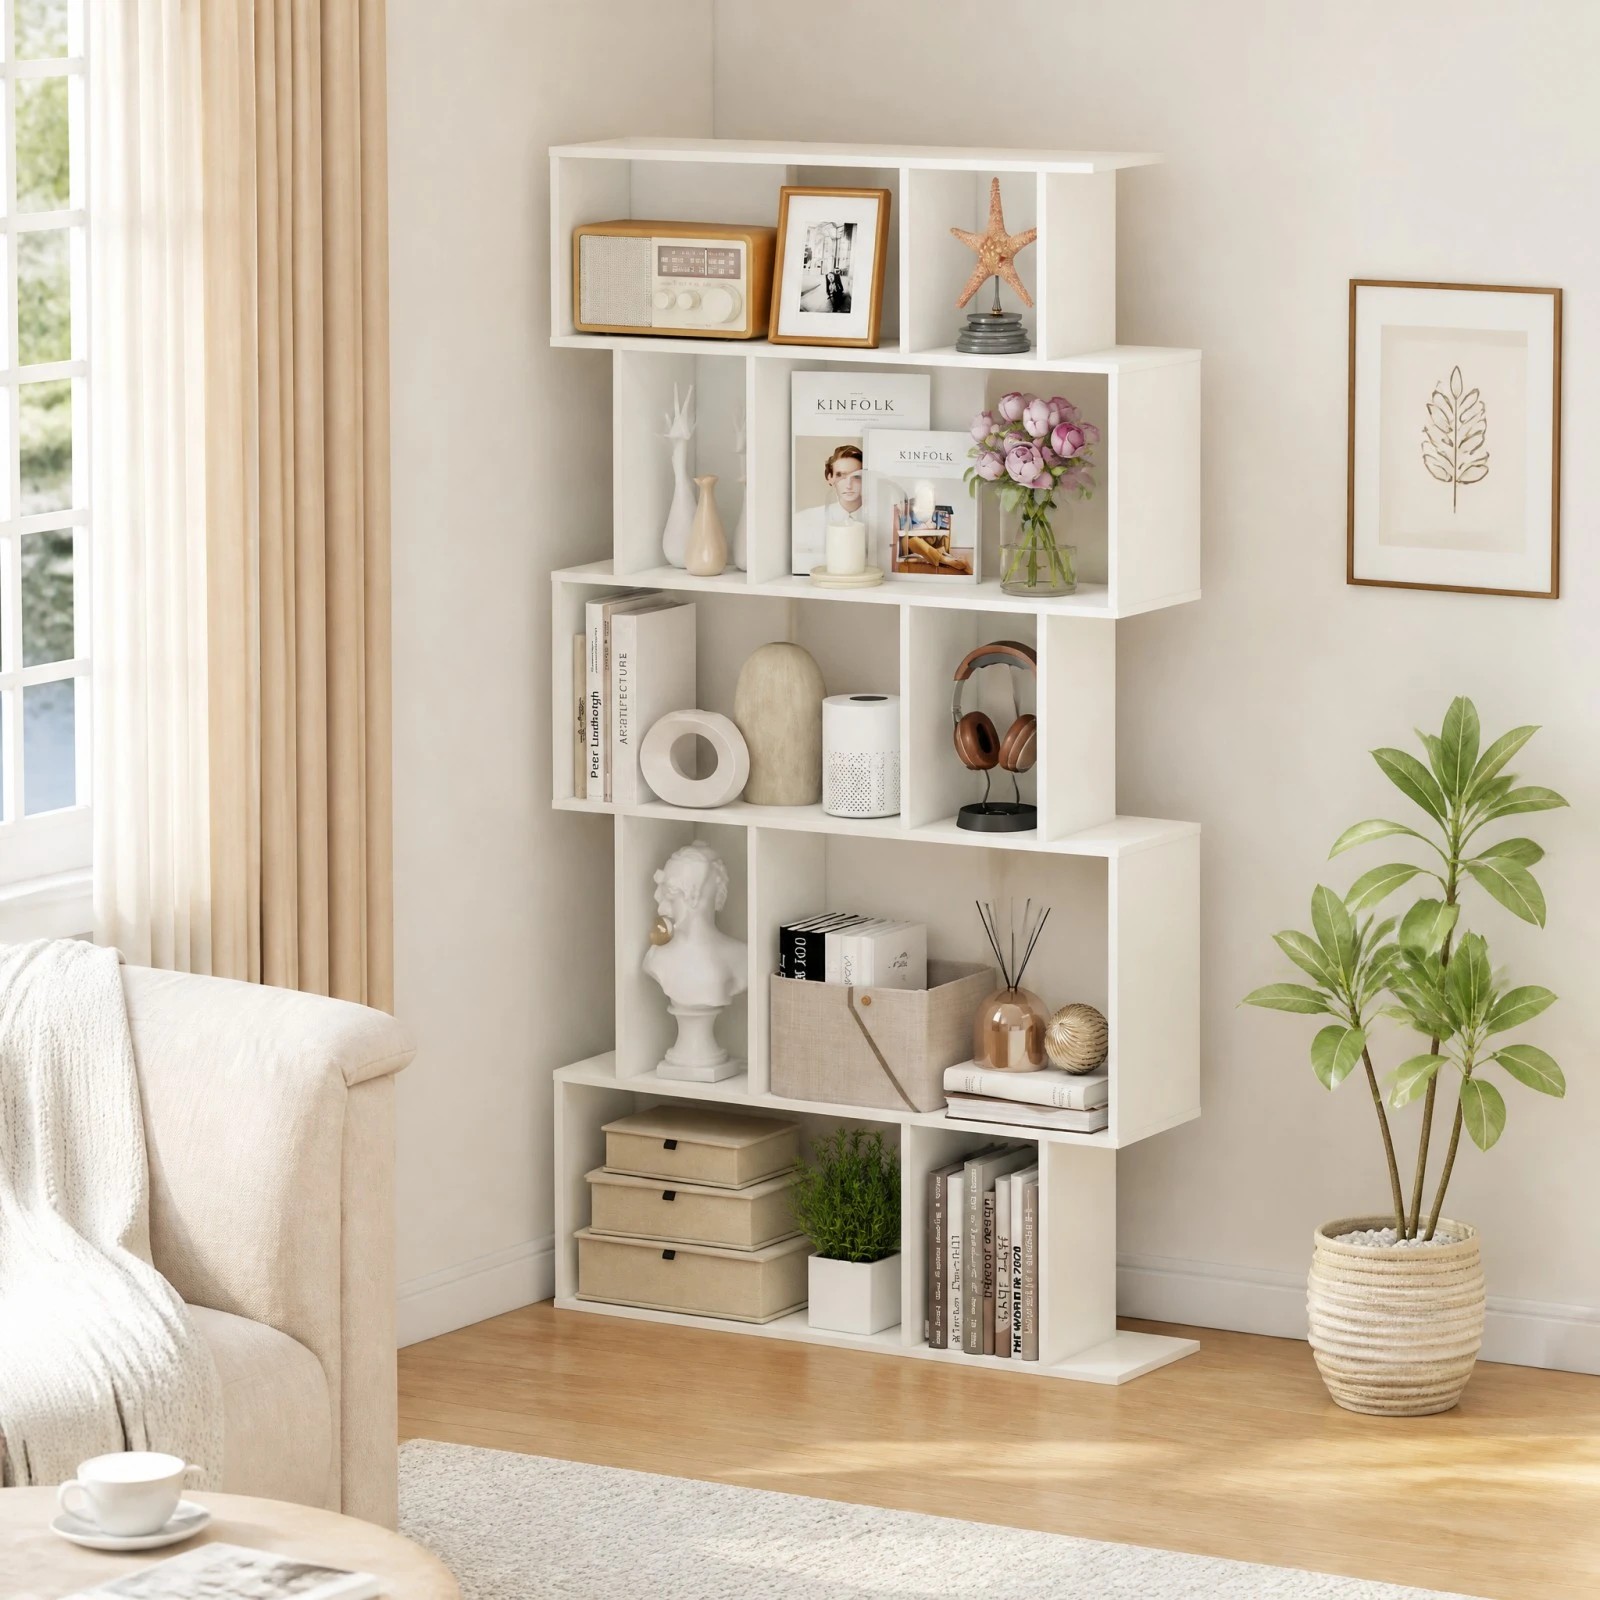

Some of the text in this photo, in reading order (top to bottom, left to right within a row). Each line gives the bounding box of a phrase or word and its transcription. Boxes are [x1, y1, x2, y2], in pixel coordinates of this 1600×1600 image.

[817, 399, 894, 411] KINFOLK
[899, 451, 953, 462] KINFOLK
[590, 751, 599, 779] Peer
